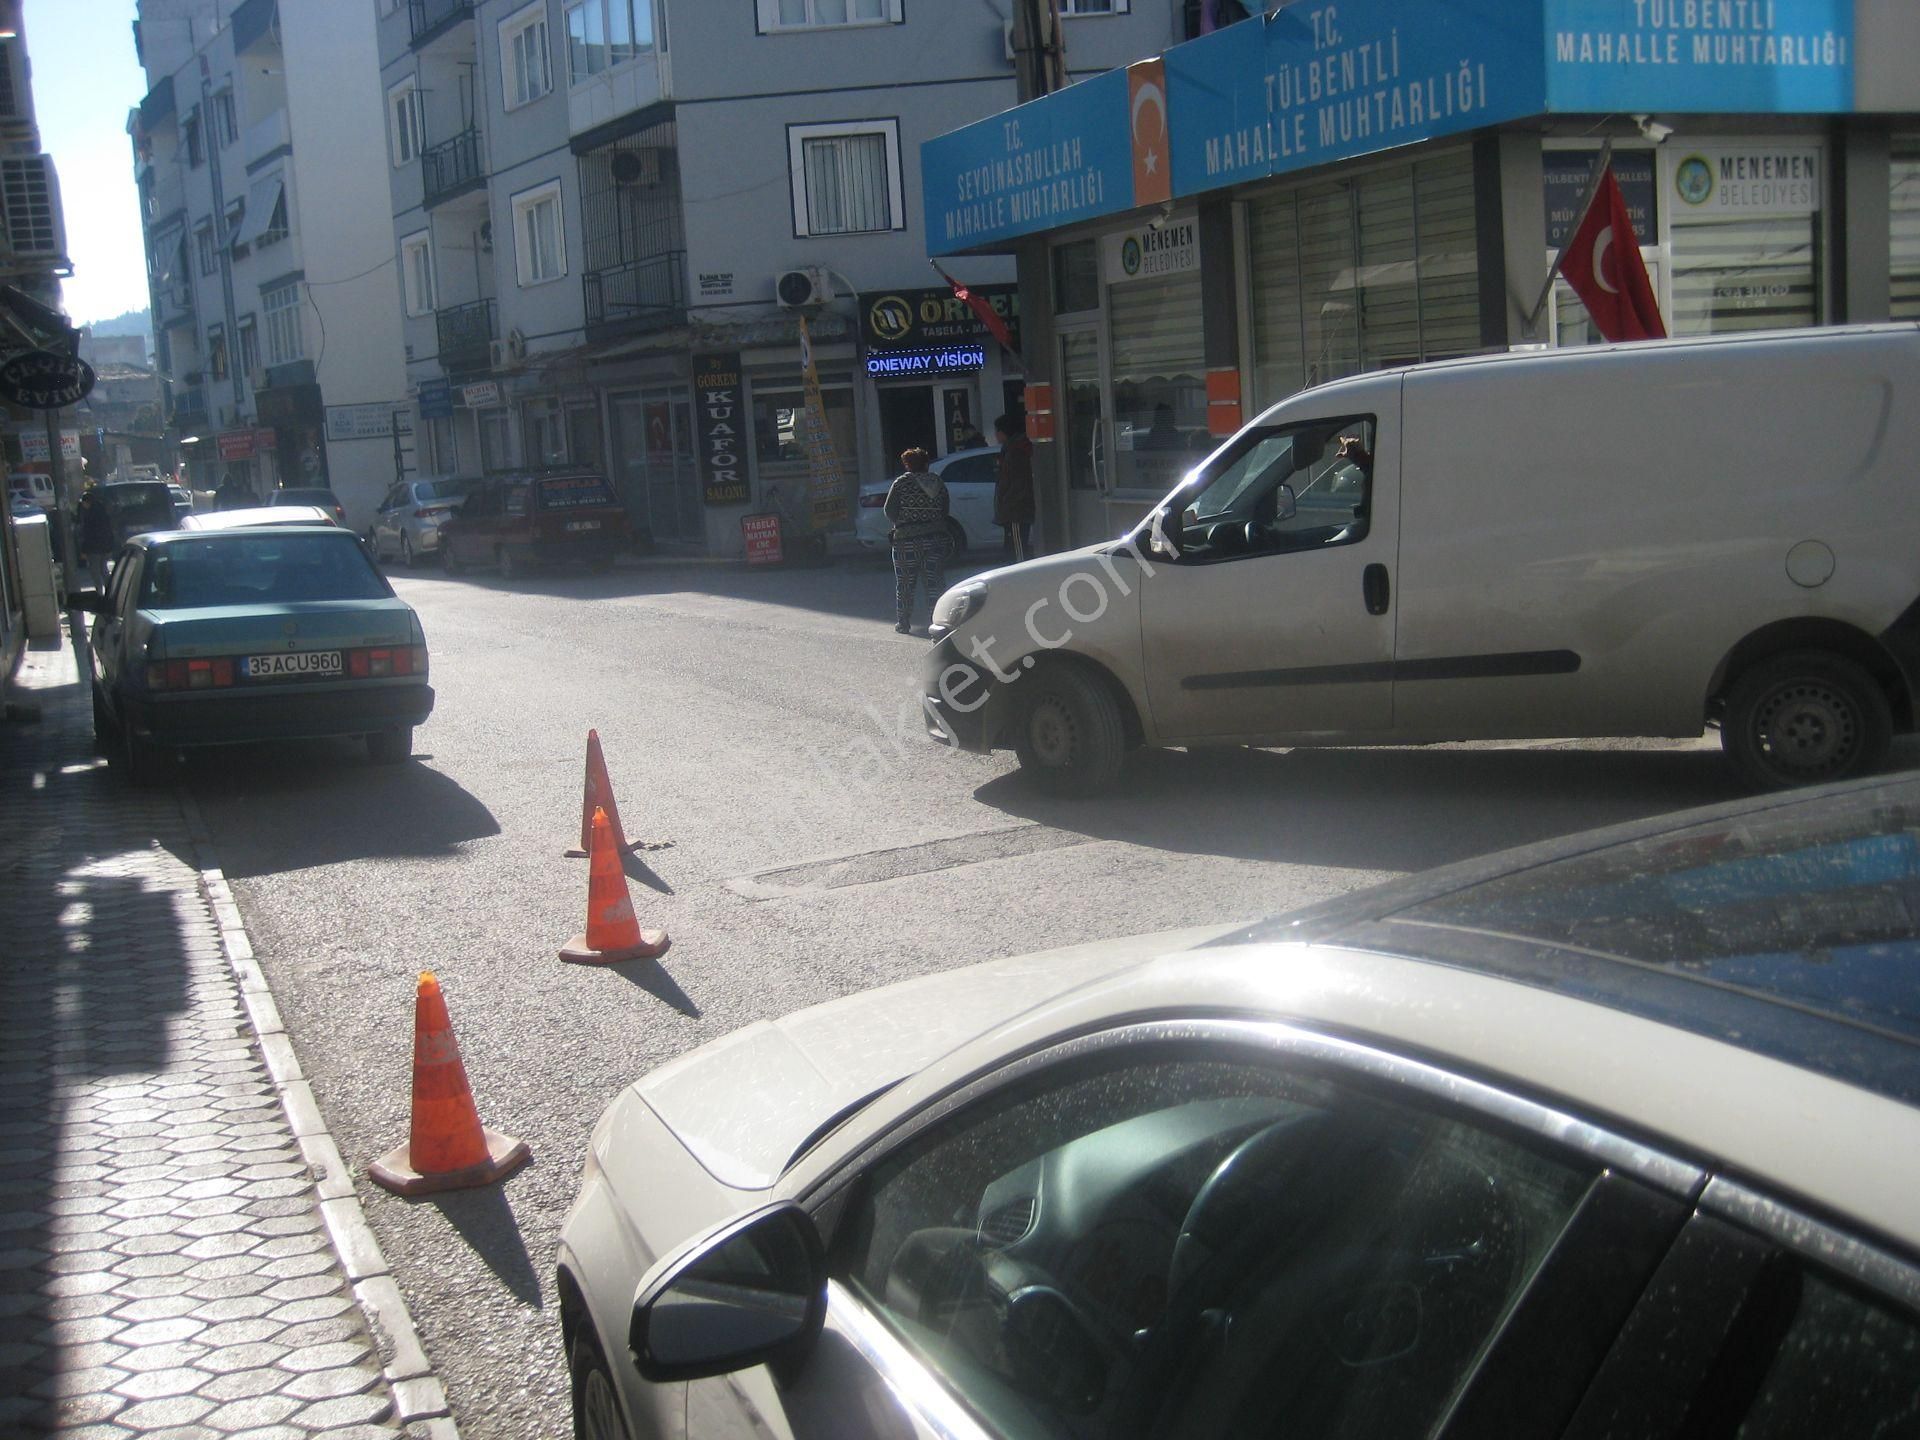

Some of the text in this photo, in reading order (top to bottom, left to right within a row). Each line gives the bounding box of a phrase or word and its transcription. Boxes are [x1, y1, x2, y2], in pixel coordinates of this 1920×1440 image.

[1310, 7, 1343, 50] T.C.
[1556, 31, 1846, 66] MAHALLE MUHTARLIĞI
[1264, 27, 1399, 112] TÜLBENTLİ
[1205, 59, 1486, 175] MAHALLE MUHTARLIĞI
[1003, 119, 1023, 151] T.C.
[957, 137, 1082, 202] SEYDİNASRULLAH
[1720, 157, 1813, 180] MENEMEN
[945, 166, 1104, 240] MAHALLE MUHTARLIĞI
[1720, 182, 1815, 206] BELEDİYESİ
[1142, 223, 1193, 253] MENEMEN
[1143, 246, 1194, 274] BELEDİYESİ
[921, 323, 964, 337] TABELA
[868, 350, 983, 372] ONEWAY VİSİON
[706, 486, 747, 502] SALONU
[746, 519, 776, 531] TABELA
